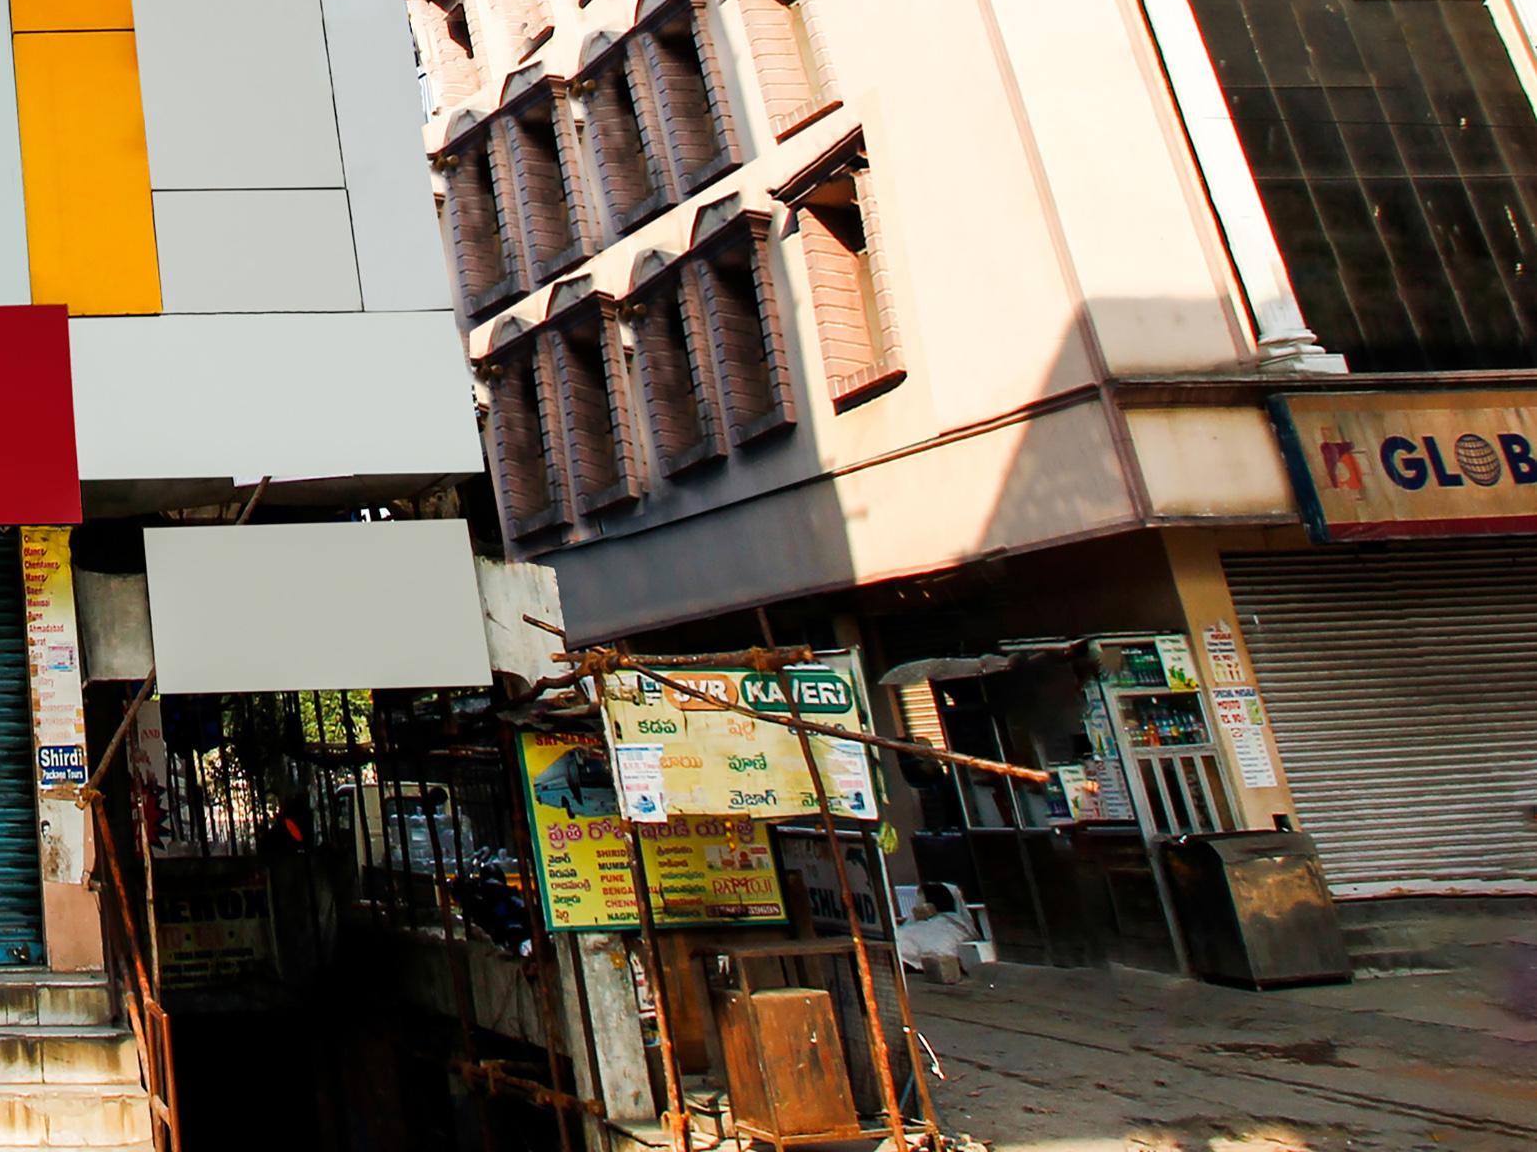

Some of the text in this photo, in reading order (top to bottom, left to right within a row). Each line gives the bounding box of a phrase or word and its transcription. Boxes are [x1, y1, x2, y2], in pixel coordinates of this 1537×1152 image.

[638, 720, 677, 735] కడప
[40, 749, 83, 766] Shirdi
[67, 769, 84, 779] Tours
[548, 823, 582, 849] ప్రతి
[596, 850, 631, 859] SHIRID
[598, 861, 631, 870] MUMBA
[600, 874, 625, 883] PUNE
[605, 899, 639, 909] CHENN
[607, 912, 640, 922] NAGPU
